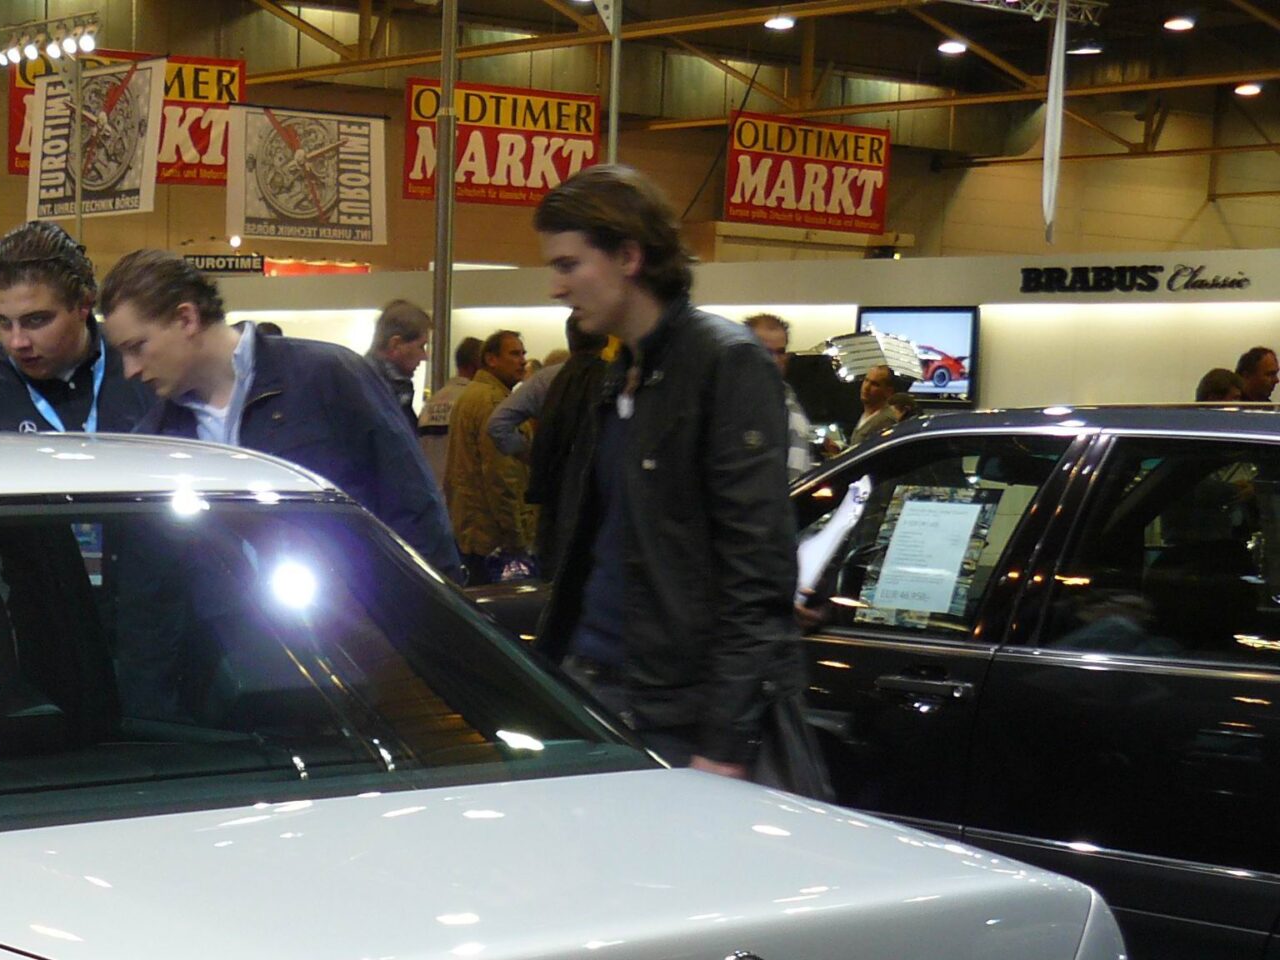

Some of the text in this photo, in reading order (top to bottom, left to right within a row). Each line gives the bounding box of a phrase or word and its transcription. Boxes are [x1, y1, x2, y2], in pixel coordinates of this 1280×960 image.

[414, 87, 593, 133] ODTIMER
[40, 80, 73, 200] EUROTIME
[736, 119, 884, 165] OLDTIMER
[730, 154, 884, 218] MARKT
[186, 257, 262, 270] EUROTIME
[1021, 263, 1252, 292] BRABUS Classic
